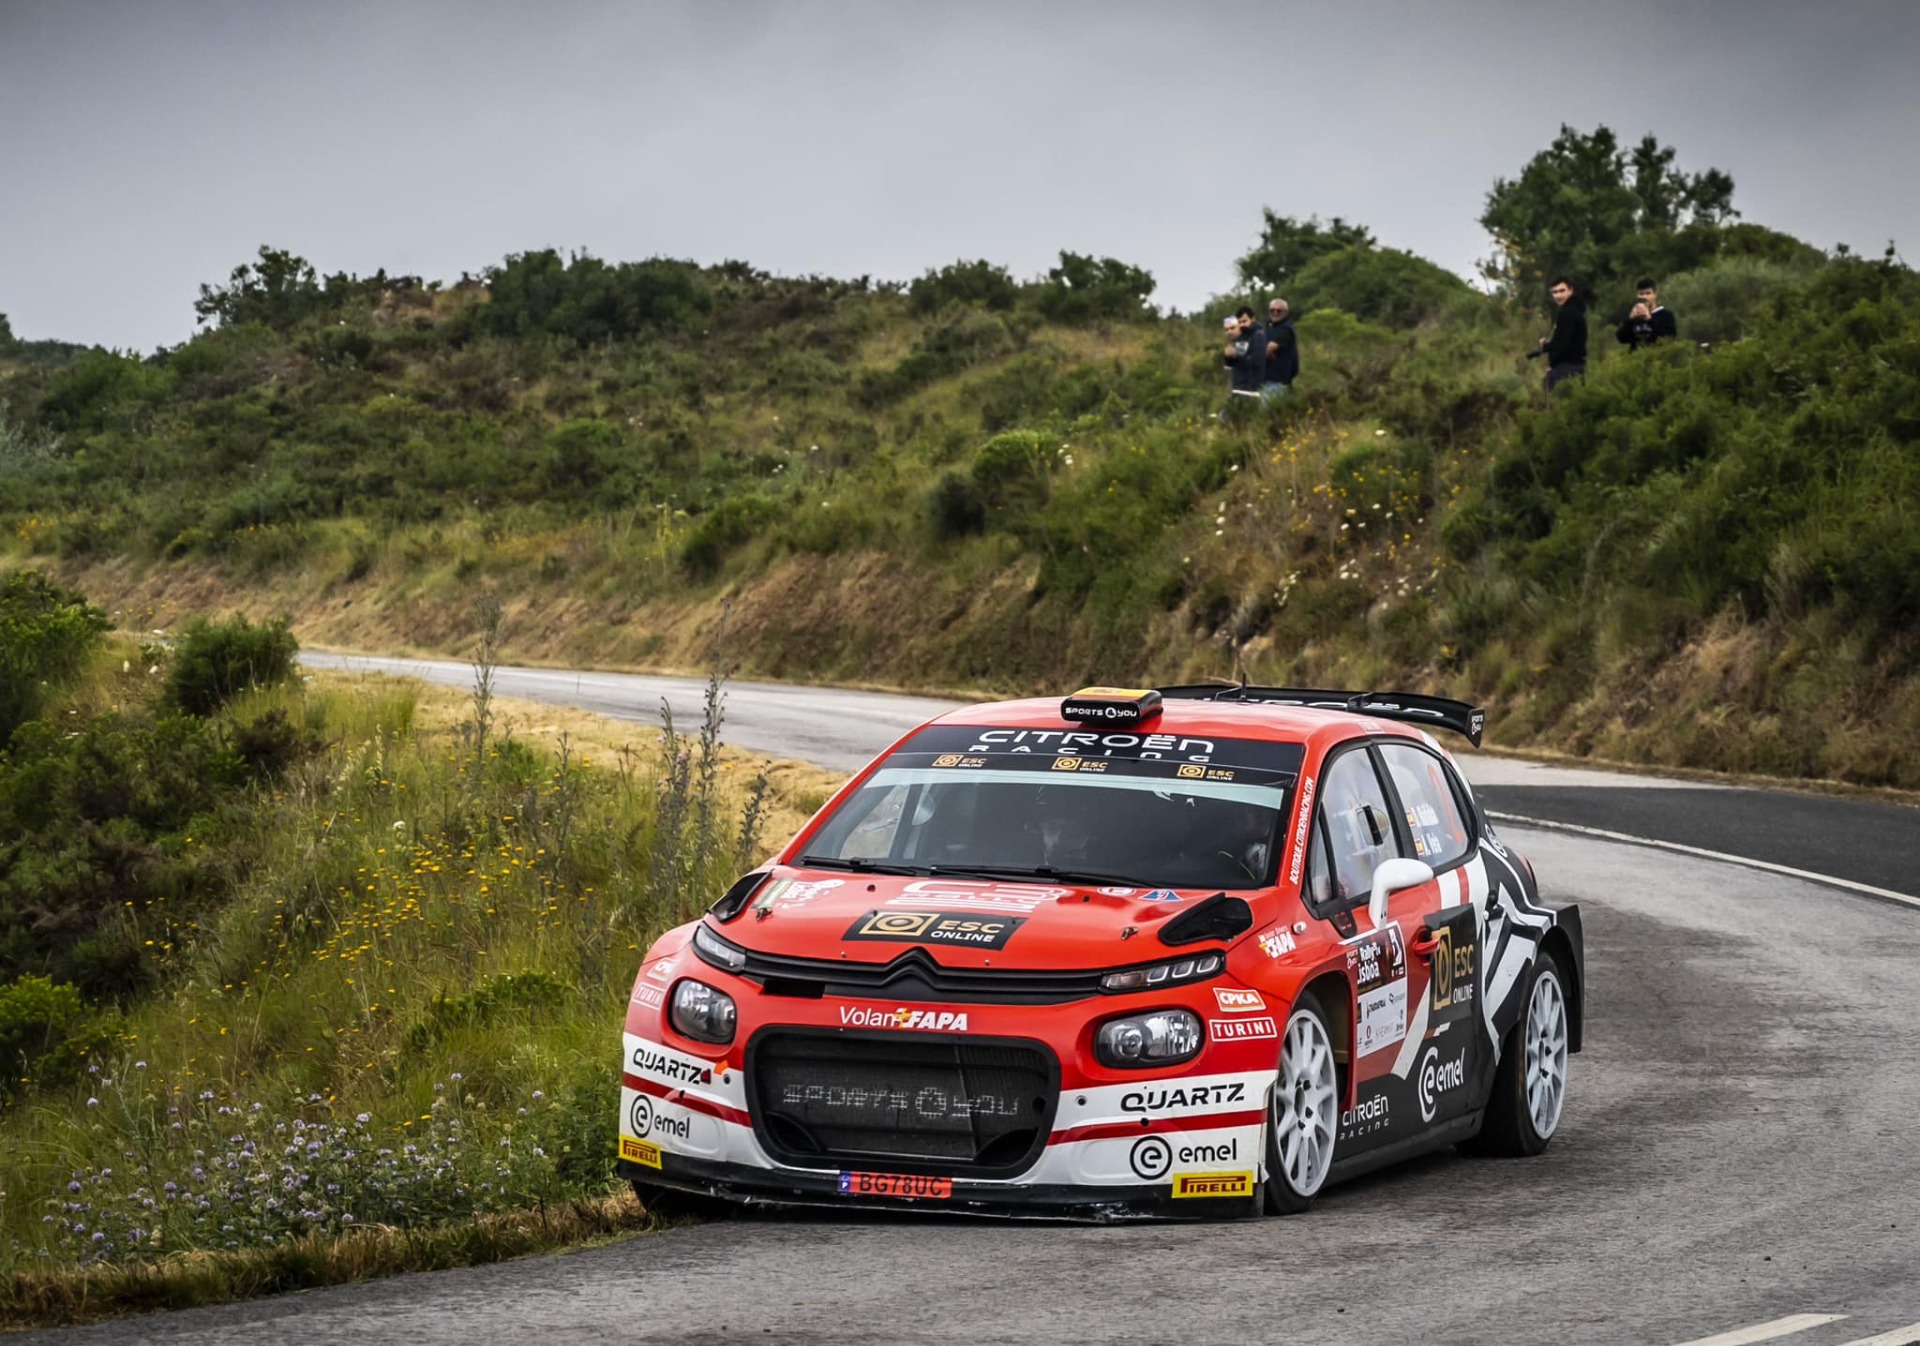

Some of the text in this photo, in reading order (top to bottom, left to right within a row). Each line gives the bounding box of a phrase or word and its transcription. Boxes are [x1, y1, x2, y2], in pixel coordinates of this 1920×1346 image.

[1065, 707, 1104, 716] SPORTS
[961, 757, 987, 765] ESC
[1082, 760, 1108, 768] ESC
[930, 930, 995, 942] ONLINE
[937, 919, 1005, 934] ESC
[1454, 944, 1474, 979] ESC
[1219, 991, 1260, 1005] CPKA
[1453, 983, 1474, 1003] ONLINE
[1215, 1020, 1272, 1037] TURINI
[632, 1048, 701, 1085] QUARTZ
[1436, 1047, 1465, 1092] emel
[1120, 1083, 1245, 1112] QUARTZ
[653, 1113, 690, 1139] emel
[1339, 1118, 1390, 1141] RACING
[623, 1139, 658, 1164] PIRELLI
[1178, 1138, 1237, 1163] emel
[859, 1173, 943, 1196] BG78UC
[1180, 1176, 1247, 1193] PIRELLI
